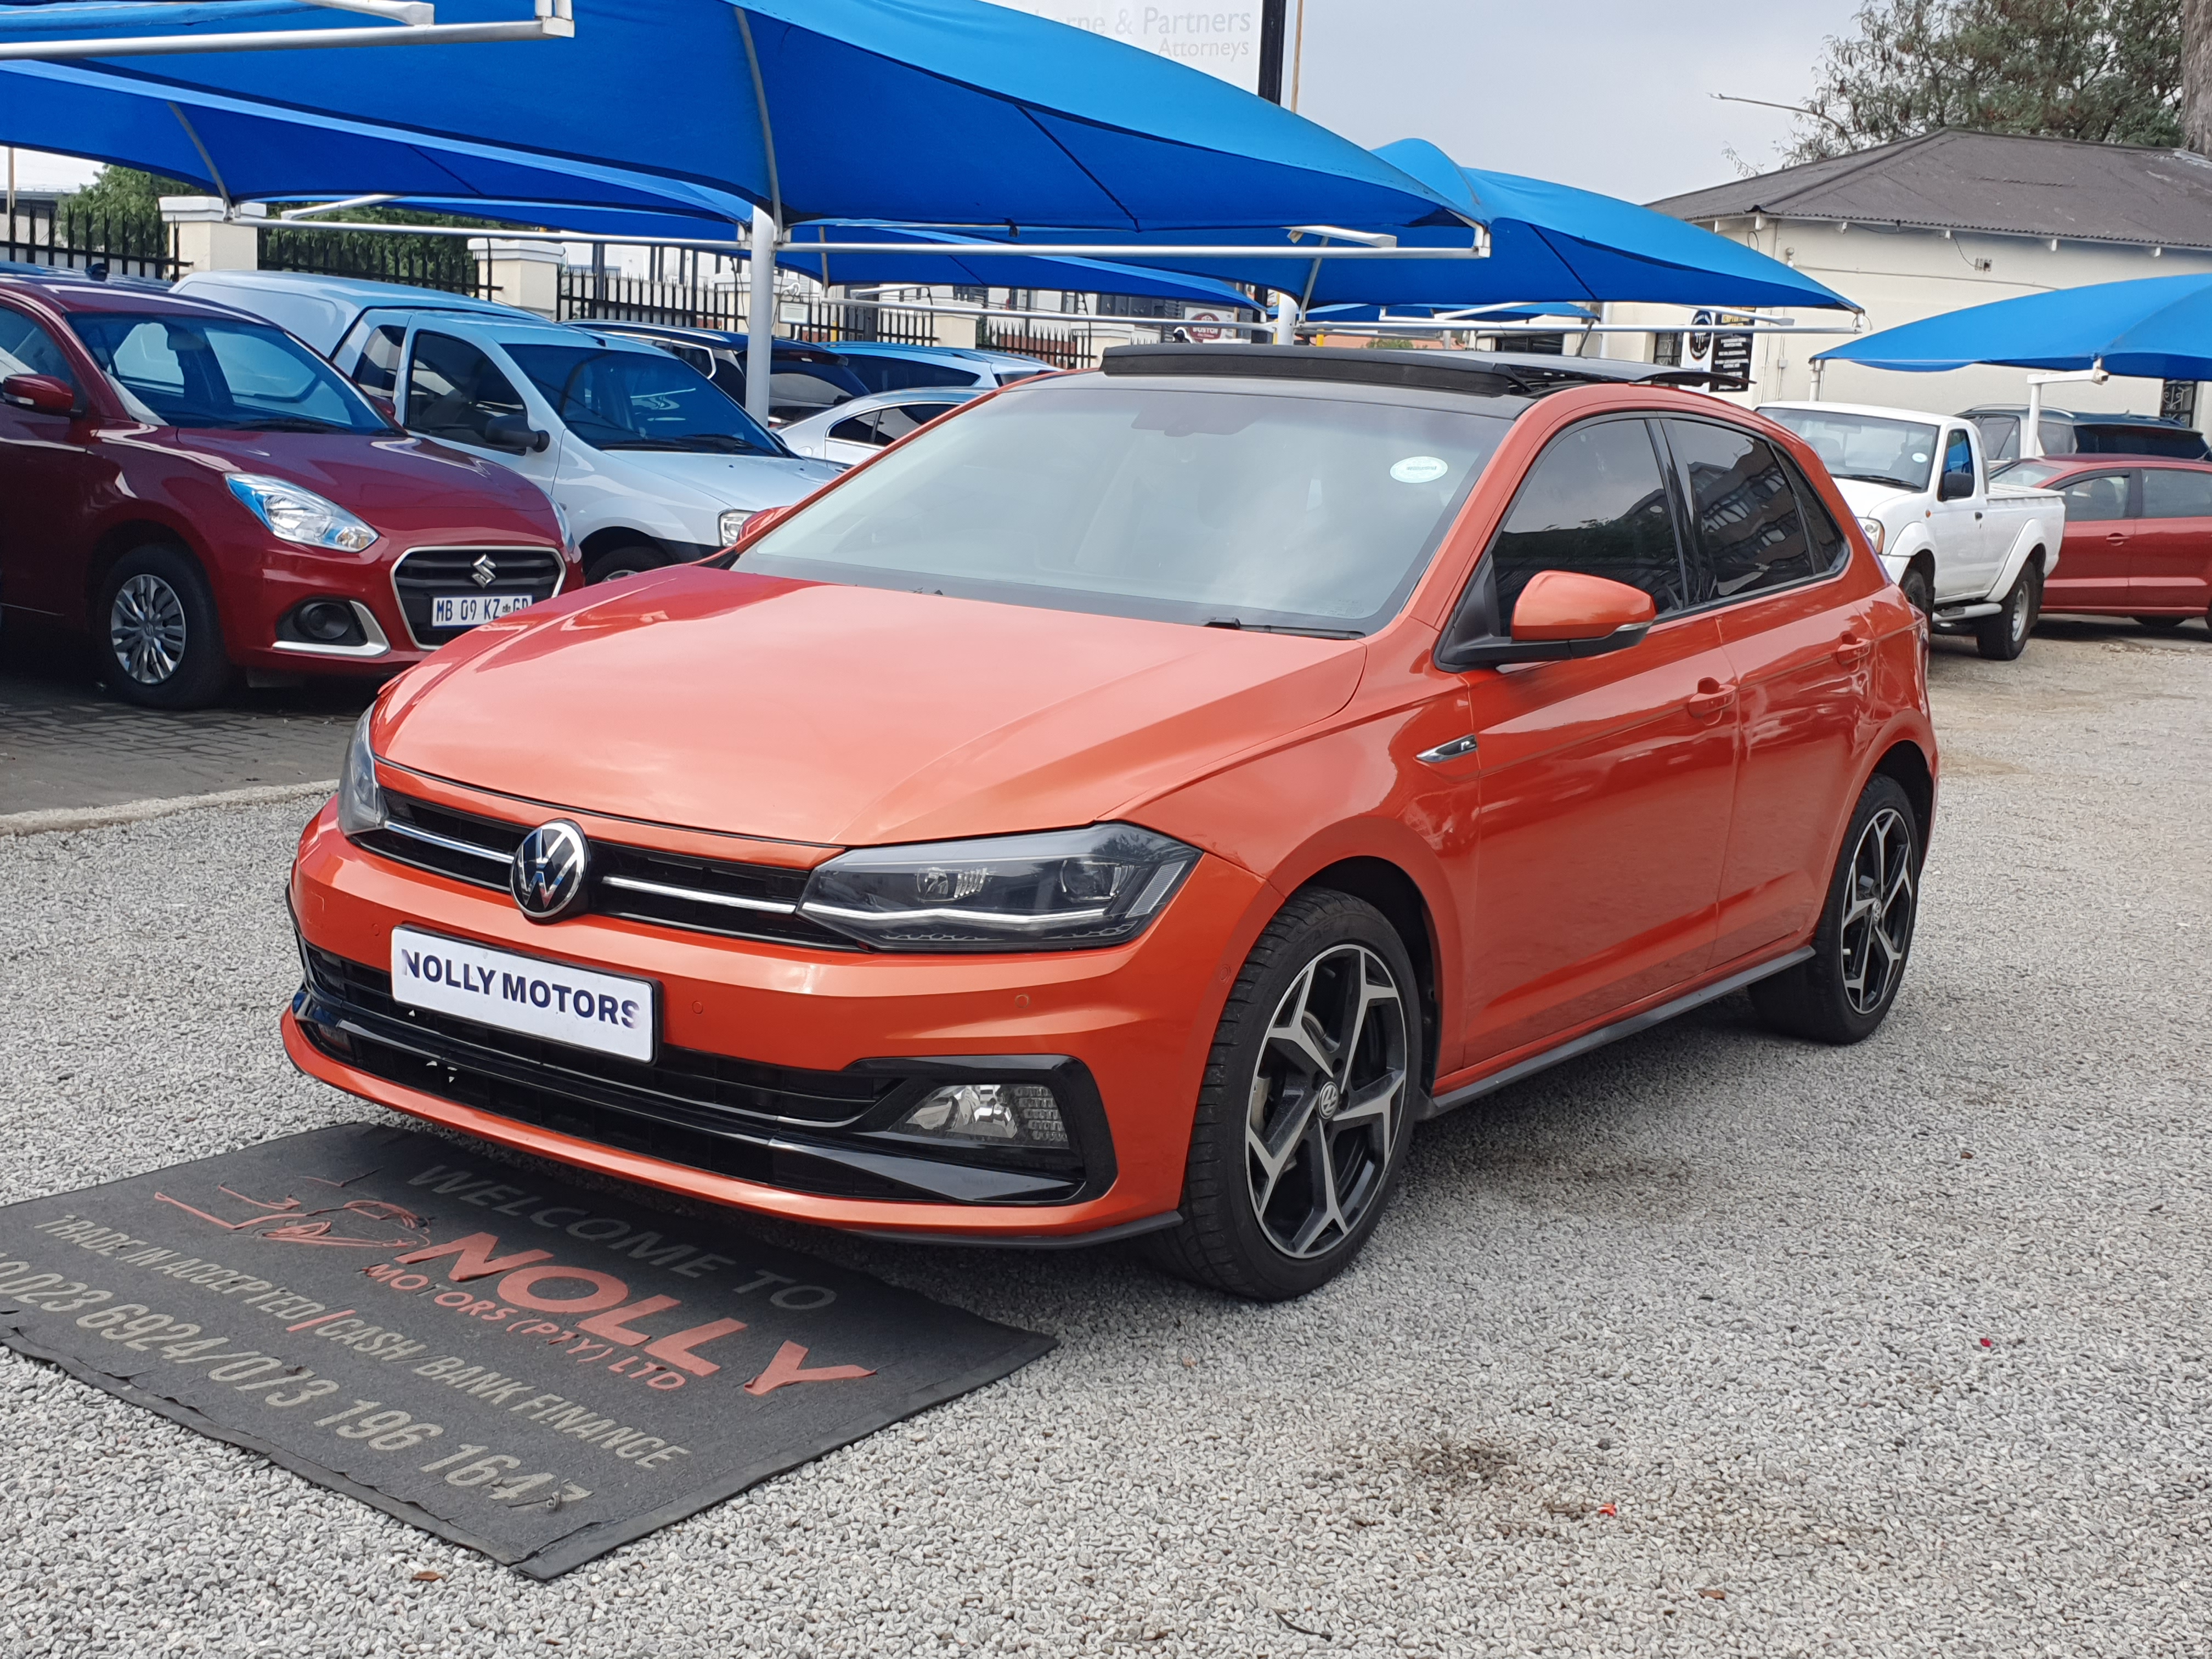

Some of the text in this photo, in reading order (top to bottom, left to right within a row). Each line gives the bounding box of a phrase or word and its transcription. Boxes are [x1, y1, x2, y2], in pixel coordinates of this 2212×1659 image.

[1115, 9, 1133, 35] &
[1144, 7, 1250, 34] Partners
[1159, 37, 1249, 62] Attorneys
[437, 600, 453, 622] MB
[460, 599, 477, 620] 09
[484, 599, 500, 620] KZ
[401, 949, 640, 1029] NOLLY MOTORS
[407, 1165, 837, 1310] WELCOME TO
[34, 1215, 148, 1256] TRADE
[116, 1247, 181, 1267] IN
[509, 1393, 691, 1469] FINANCE
[363, 1263, 518, 1321] MOTORS
[608, 1356, 686, 1390] LTD
[394, 1232, 877, 1395] NOLLY
[314, 1398, 444, 1450] 196
